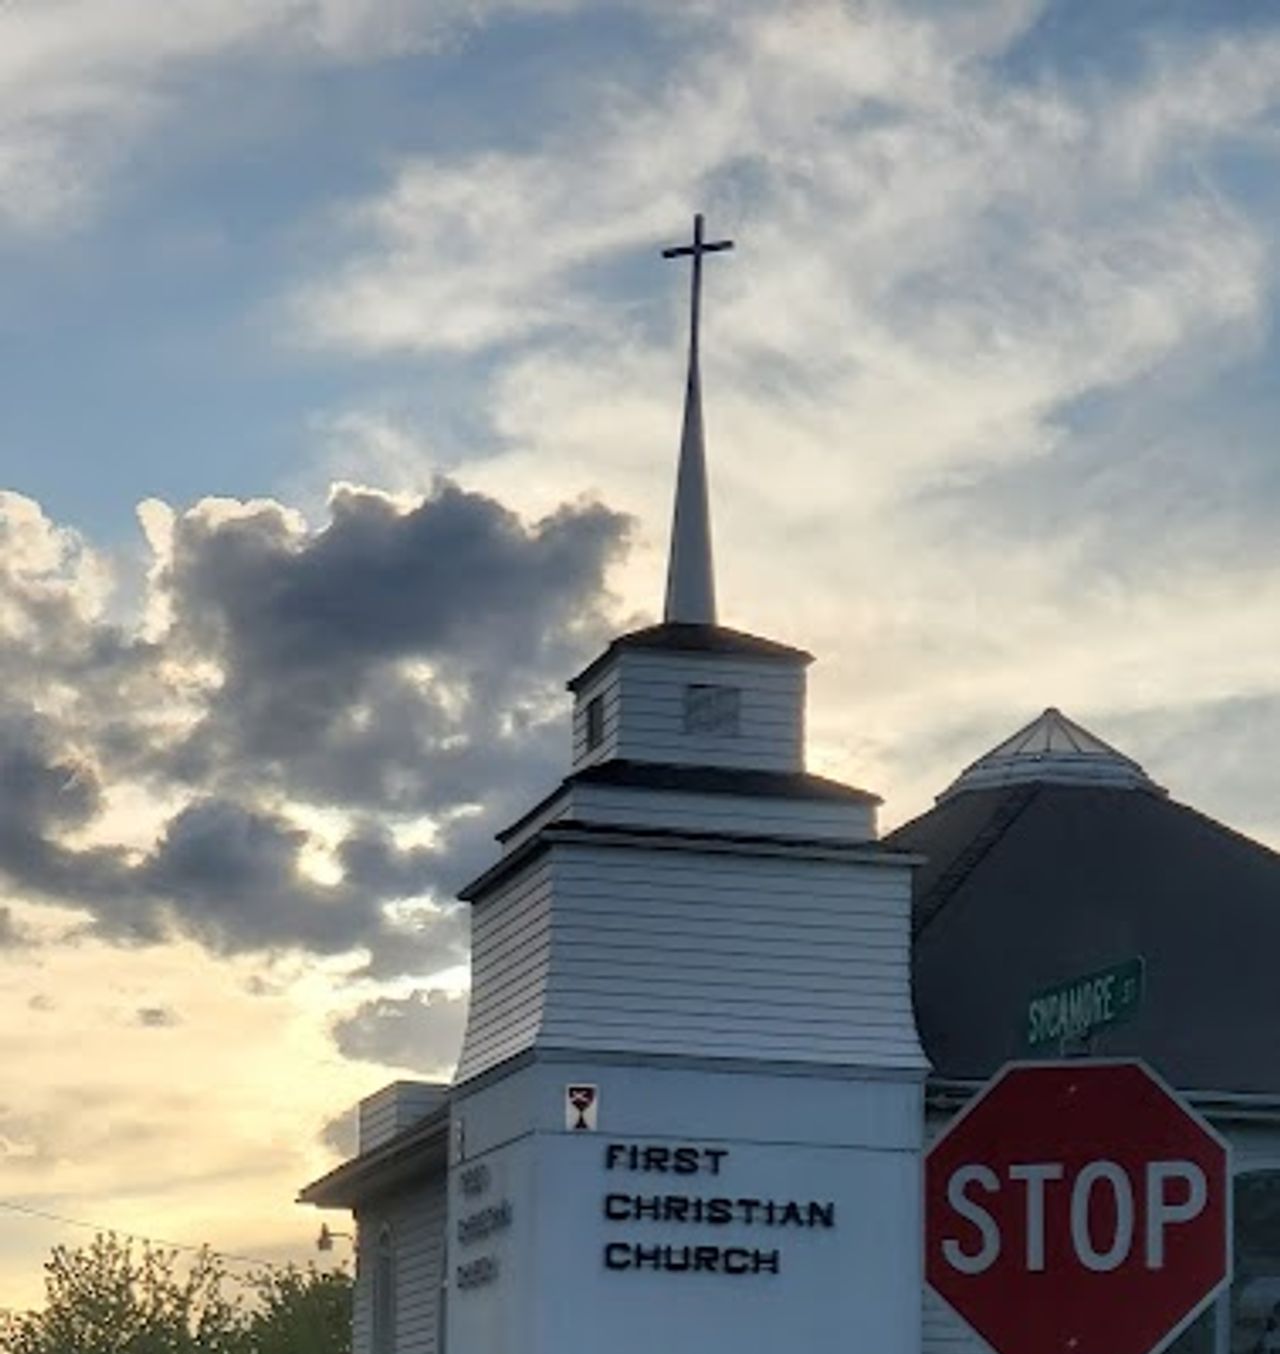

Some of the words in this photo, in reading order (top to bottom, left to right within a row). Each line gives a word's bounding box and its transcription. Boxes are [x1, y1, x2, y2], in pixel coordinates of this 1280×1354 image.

[1028, 974, 1115, 1044] SYCAMORE
[604, 1143, 729, 1175] FIRST
[603, 1193, 836, 1229] CHRISTIAN
[940, 1159, 1209, 1276] STOP
[603, 1241, 781, 1276] CHURCH
